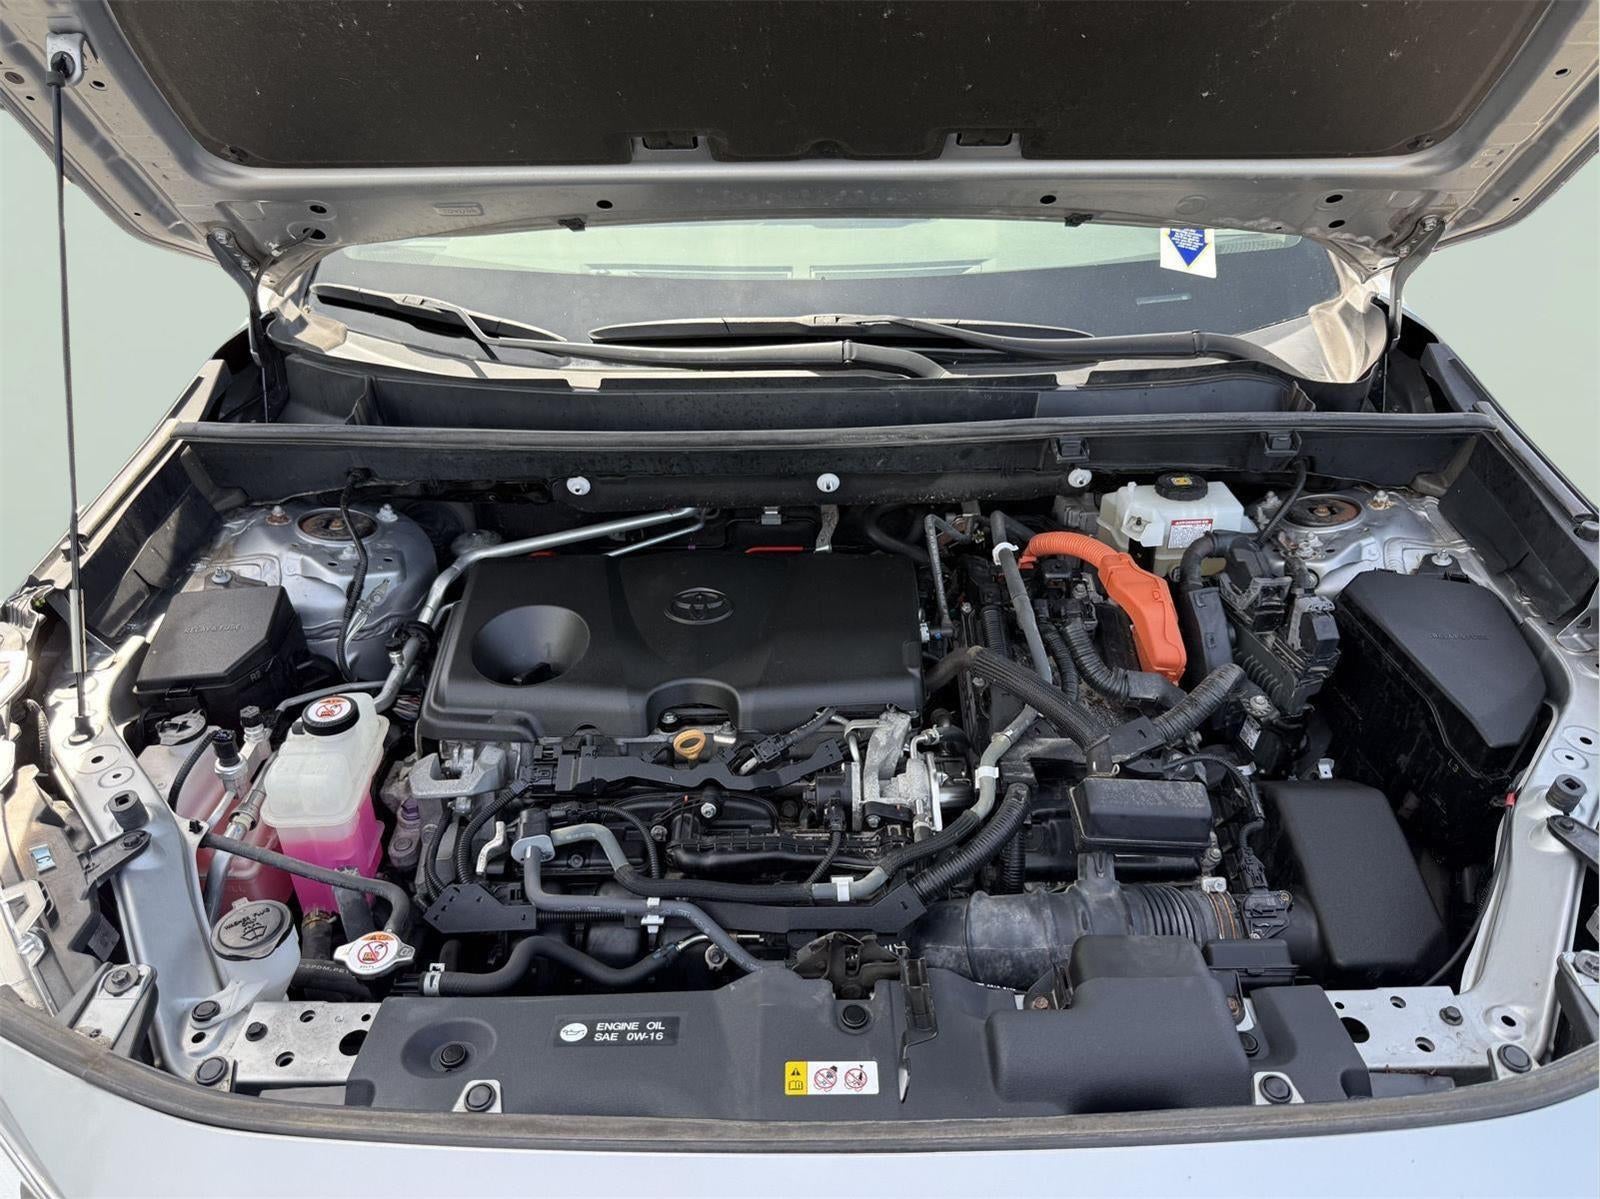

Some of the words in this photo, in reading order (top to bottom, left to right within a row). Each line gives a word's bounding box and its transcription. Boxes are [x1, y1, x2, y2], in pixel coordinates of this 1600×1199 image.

[596, 1022, 640, 1031] ENGINE
[646, 1021, 665, 1030] OIL
[594, 1032, 619, 1041] SAE
[626, 1031, 664, 1041] 0W-16
